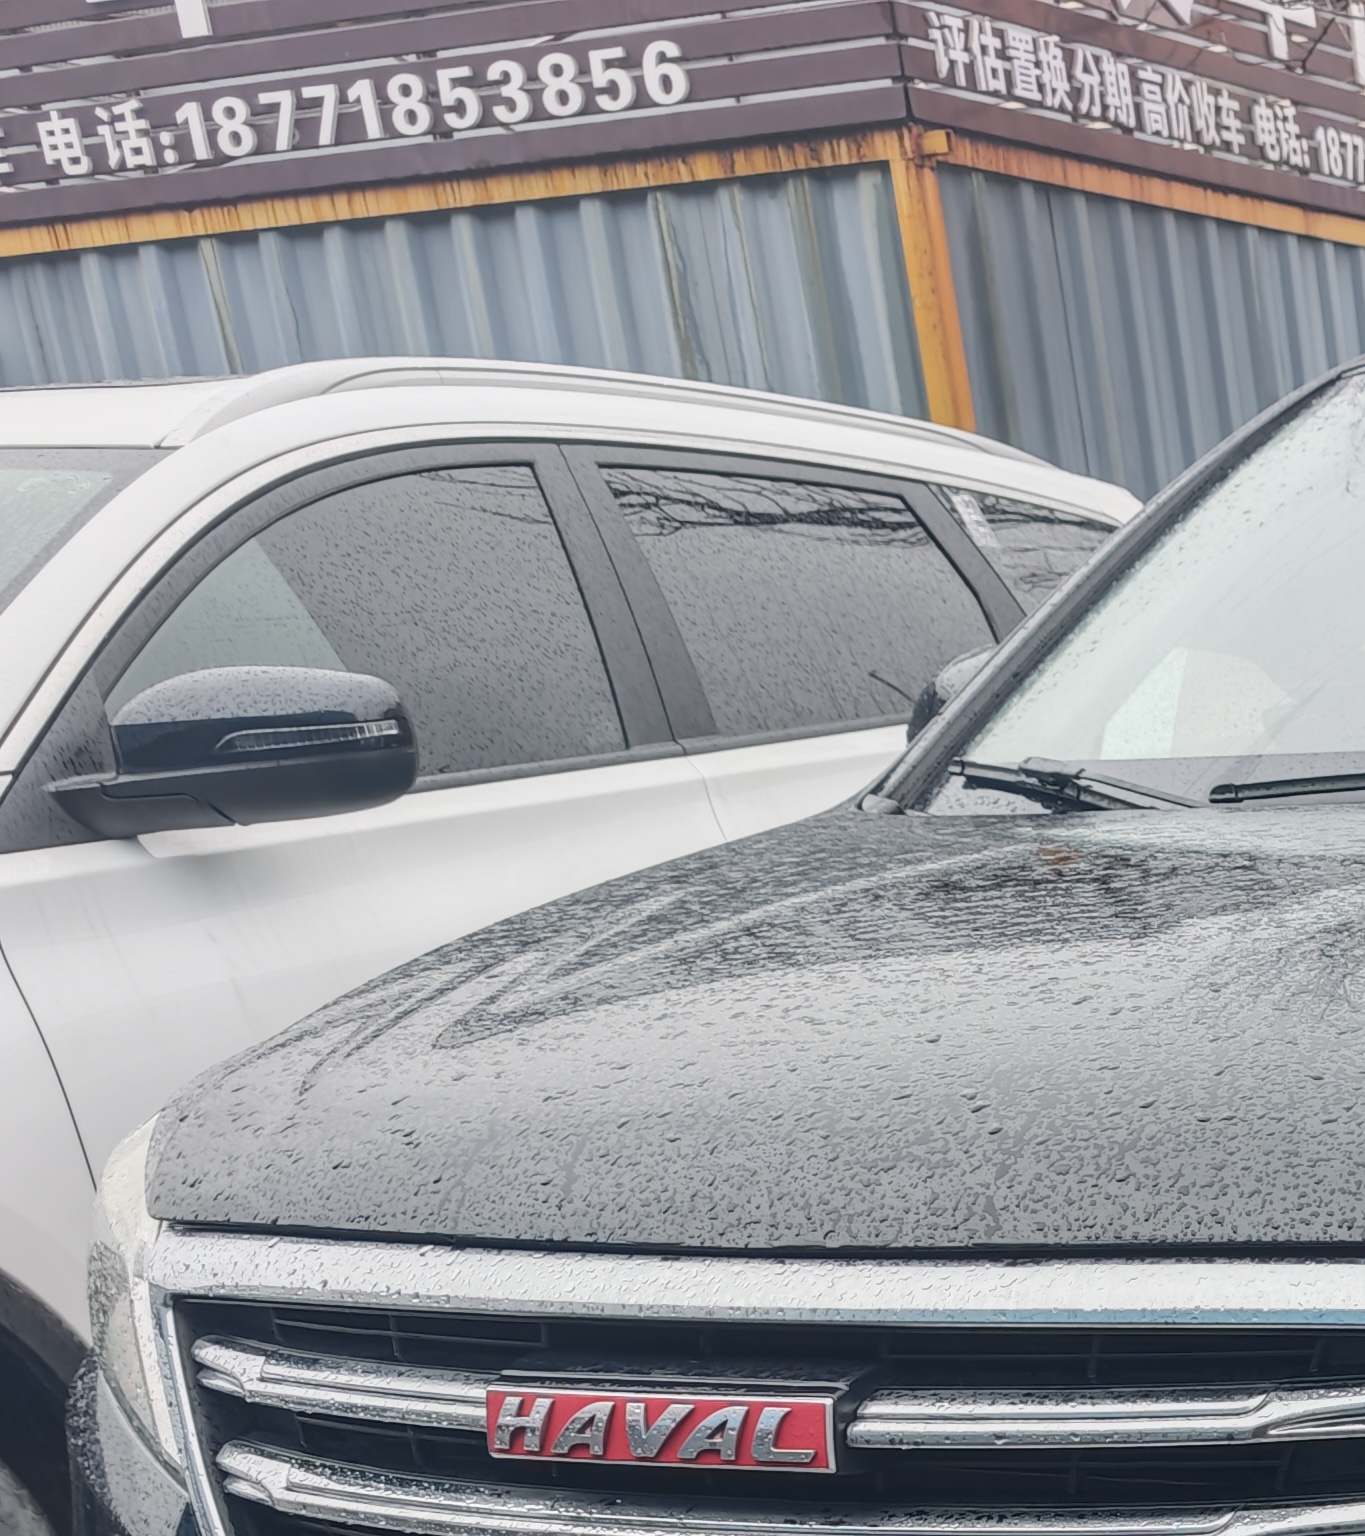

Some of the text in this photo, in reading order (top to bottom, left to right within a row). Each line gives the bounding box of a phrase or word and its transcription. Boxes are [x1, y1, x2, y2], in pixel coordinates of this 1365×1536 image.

[1072, 48, 1136, 128] 分期
[1137, 66, 1247, 154] 高价收车
[494, 1396, 817, 1464] HAVAL
